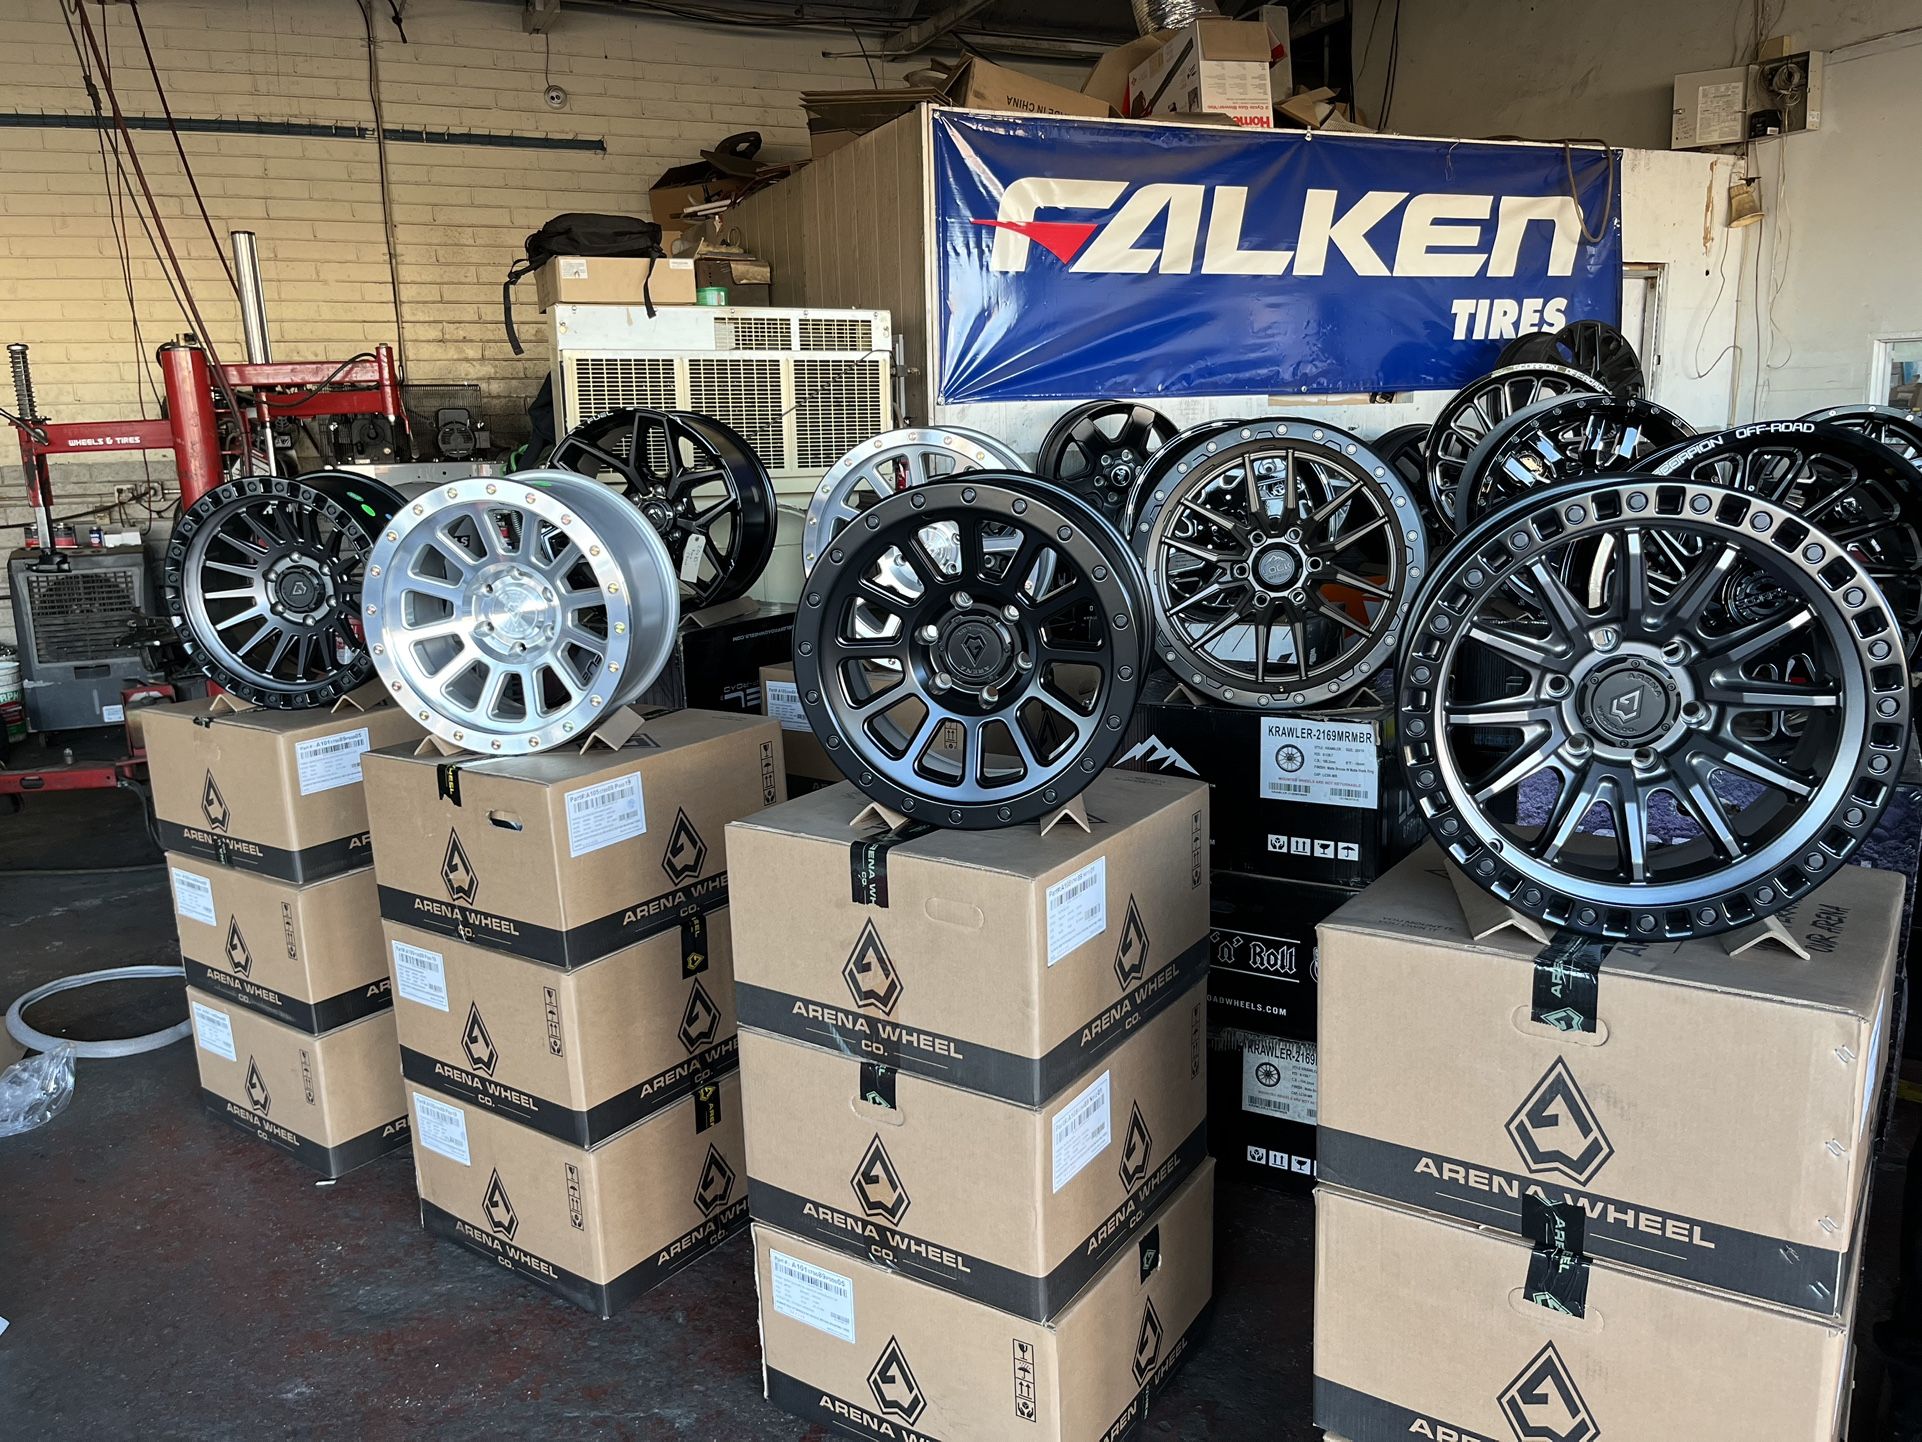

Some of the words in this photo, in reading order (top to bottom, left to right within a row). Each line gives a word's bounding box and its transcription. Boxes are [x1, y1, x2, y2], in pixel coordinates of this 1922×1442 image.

[1006, 95, 1036, 112] CHINA
[976, 177, 1582, 278] FALKEN
[1451, 298, 1568, 341] TIRES
[586, 410, 614, 424] FUEL
[1735, 422, 1816, 440] OFF-ROAD
[115, 436, 141, 445] TIRES
[1627, 672, 1662, 698] ARENA
[1268, 725, 1372, 743] KRAWLER-2169MRMBR
[414, 898, 462, 922] ARENA
[466, 911, 520, 937] WHEEL
[622, 892, 686, 926] ARENA
[679, 903, 701, 918] CO.
[1810, 904, 1852, 934] ARENA
[1805, 934, 1839, 952] OUR
[1250, 942, 1297, 975] Roll
[206, 968, 243, 989] ARENA
[244, 982, 283, 1005] WHEEL
[238, 993, 251, 1004] CO.
[1079, 999, 1131, 1047] ARENA
[1132, 965, 1181, 1004] WHEEL
[791, 1000, 871, 1034] ARENA
[877, 1022, 964, 1060] WHEEL
[1124, 1015, 1142, 1031] CO.
[861, 1039, 889, 1057] CO.
[434, 1063, 482, 1090] ARENA
[486, 1080, 539, 1111] WHEEL
[639, 1060, 699, 1099] ARENA
[694, 1068, 714, 1084] CO.
[478, 1094, 496, 1108] CO.
[226, 1103, 261, 1126] ARENA
[262, 1122, 300, 1146] WHEEL
[257, 1130, 270, 1142] CO.
[1087, 1199, 1137, 1256] ARENA
[1137, 1154, 1181, 1202] WHEEL
[1413, 1157, 1548, 1198] ARENA
[1564, 1193, 1716, 1249] WHEEL
[1128, 1210, 1145, 1229] CO.
[455, 1221, 502, 1251] ARENA
[507, 1243, 559, 1279] WHEEL
[657, 1221, 715, 1266] ARENA
[709, 1231, 729, 1246] CO.
[803, 1201, 881, 1242] ARENA
[886, 1230, 972, 1274] WHEEL
[497, 1255, 516, 1271] CO.
[870, 1244, 898, 1263] CO.
[818, 1395, 896, 1439] ARENA
